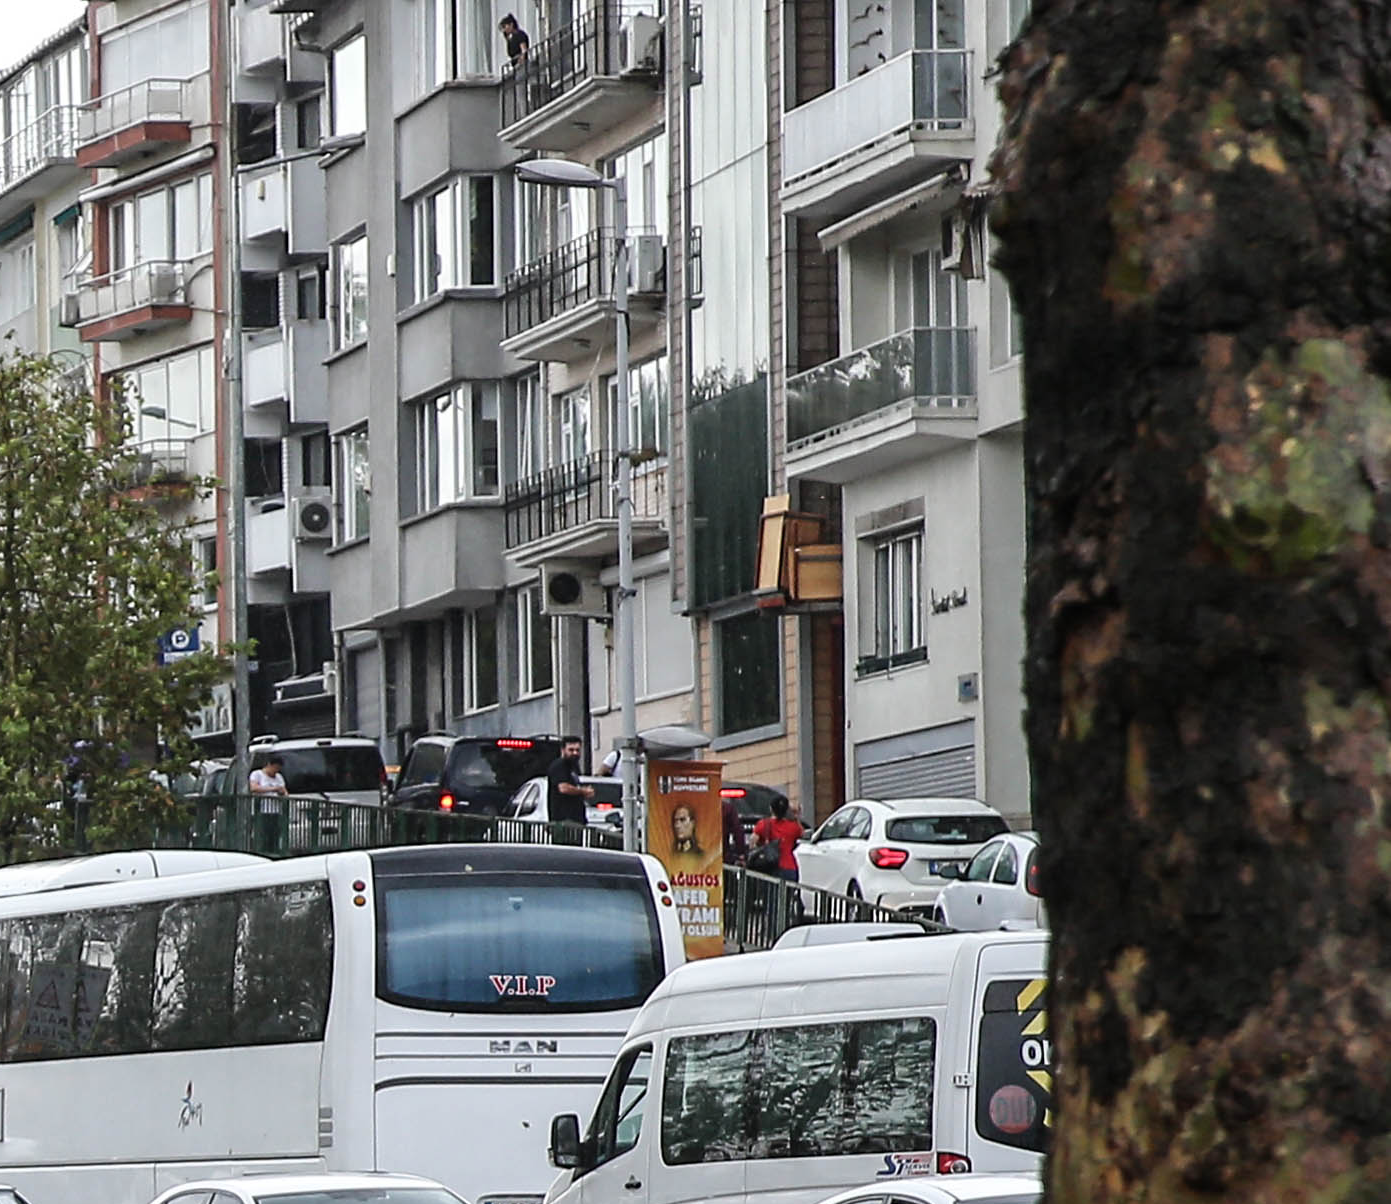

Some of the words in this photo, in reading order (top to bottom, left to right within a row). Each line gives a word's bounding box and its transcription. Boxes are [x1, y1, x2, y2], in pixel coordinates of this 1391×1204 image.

[670, 871, 720, 888] AĞUSTOS
[673, 889, 708, 905] AFER
[677, 907, 720, 923] RAMI
[489, 1040, 558, 1053] MAN
